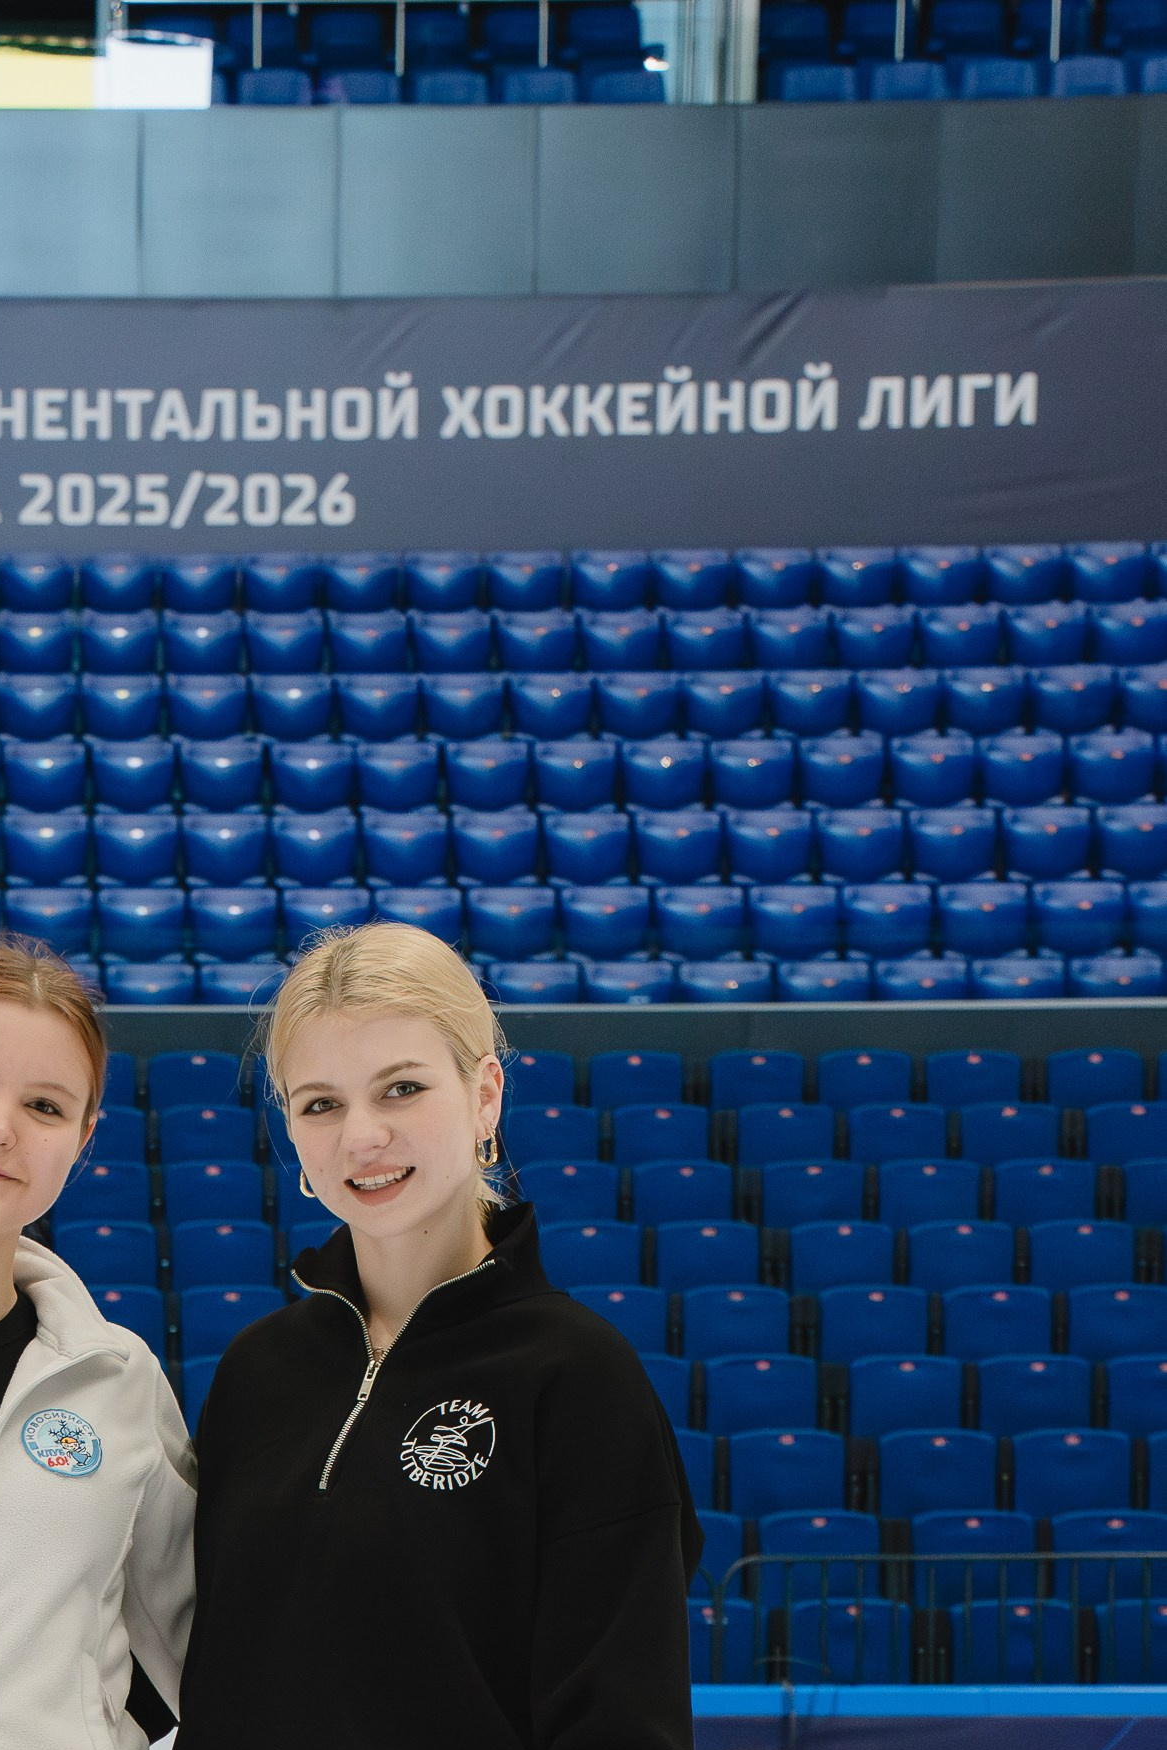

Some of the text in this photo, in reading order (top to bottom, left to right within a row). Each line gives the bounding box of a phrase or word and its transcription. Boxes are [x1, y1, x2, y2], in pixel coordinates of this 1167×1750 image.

[440, 361, 838, 439] ХОККЕЙНОЙ
[857, 372, 1039, 430] ЛИГИ
[18, 472, 356, 529] 2025/2026
[436, 1400, 490, 1419] TEAM
[400, 1437, 490, 1490] TUTBERIDZE
